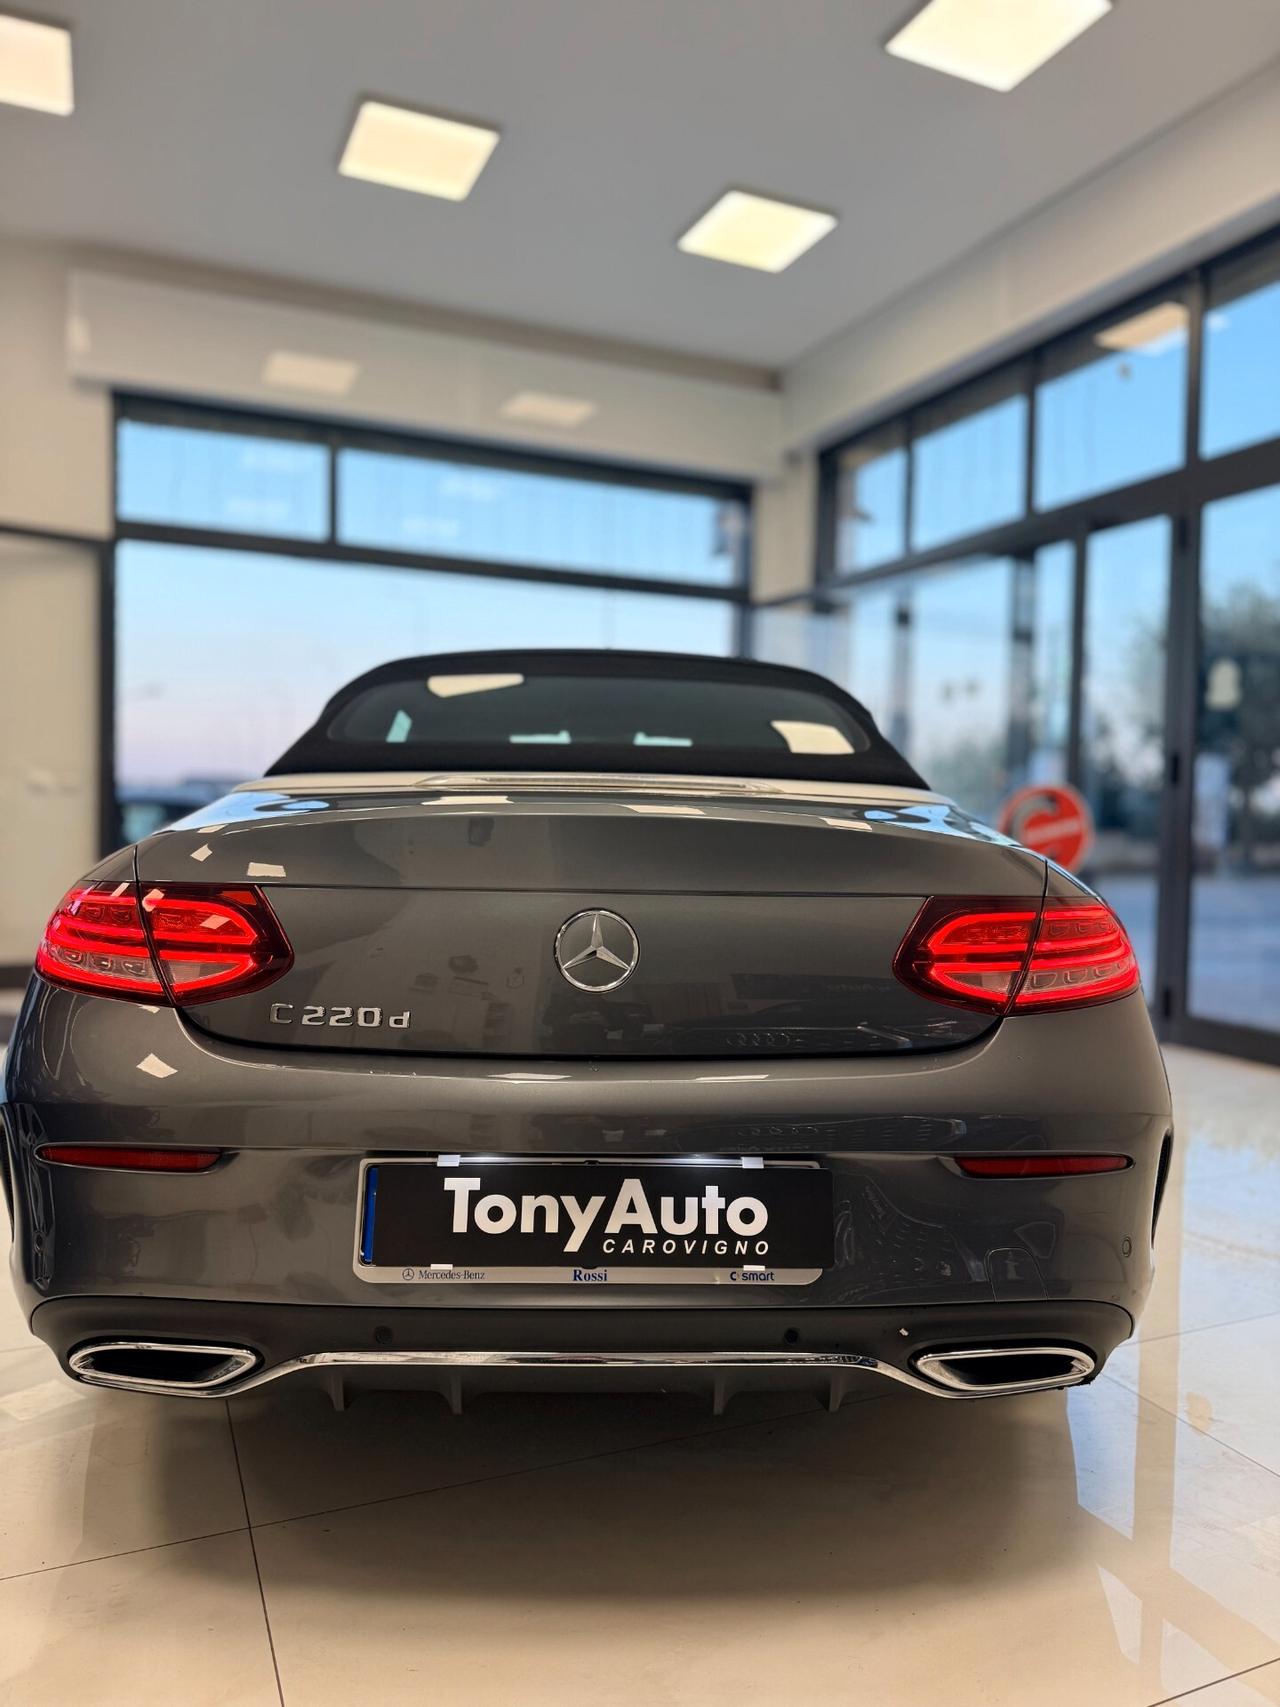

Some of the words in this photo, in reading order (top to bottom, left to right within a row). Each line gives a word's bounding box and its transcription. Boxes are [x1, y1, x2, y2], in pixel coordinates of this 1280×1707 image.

[444, 1177, 769, 1253] TonyAuto
[602, 1239, 769, 1255] CAROVIGNO
[418, 1269, 486, 1280] Mercedes-Benz
[572, 1268, 608, 1282] Rossi
[741, 1271, 775, 1281] smart
